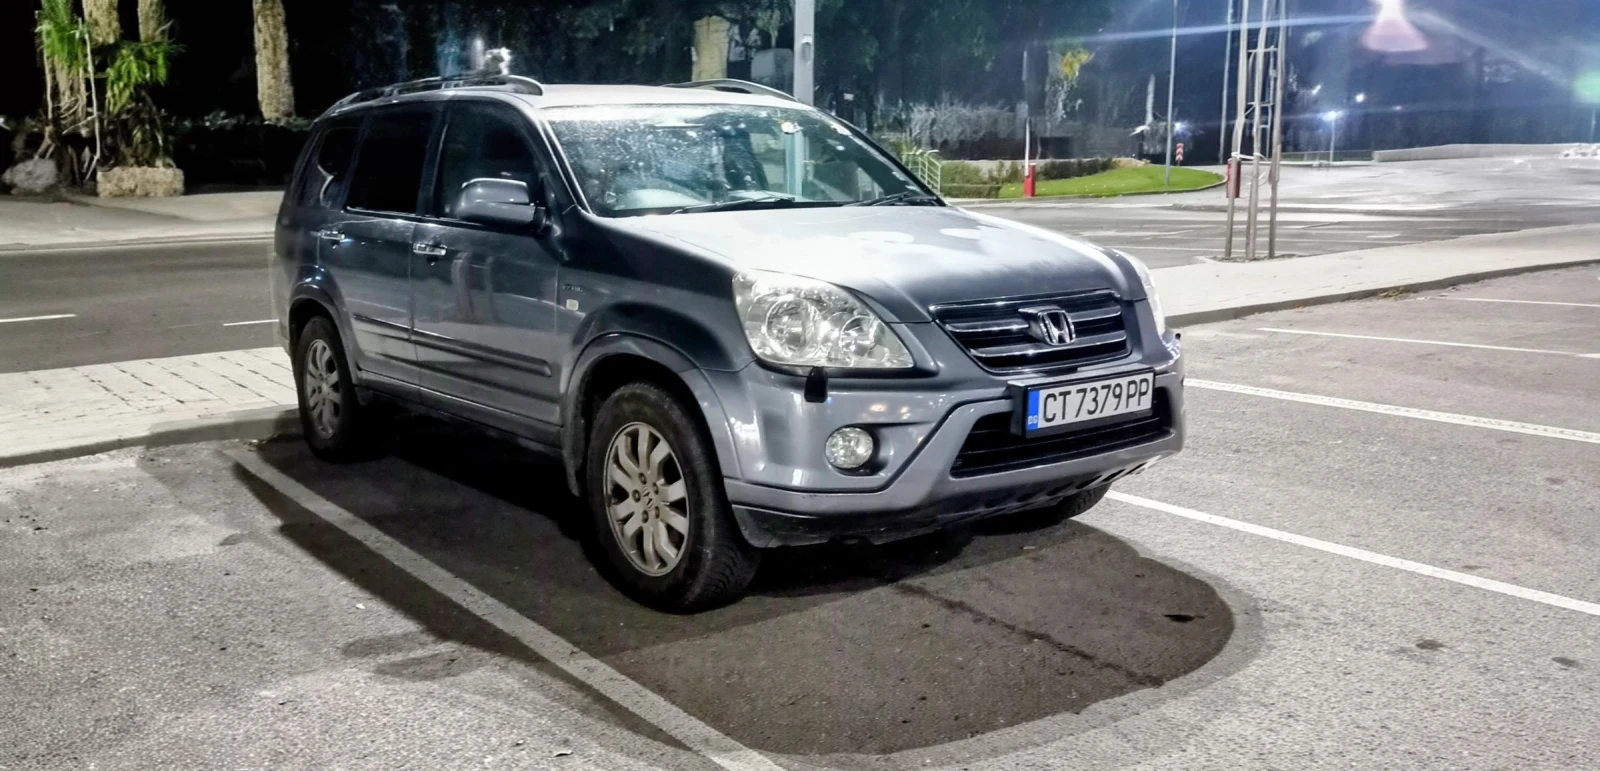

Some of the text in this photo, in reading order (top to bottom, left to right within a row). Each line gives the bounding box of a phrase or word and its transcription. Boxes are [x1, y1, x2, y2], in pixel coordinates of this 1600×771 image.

[1043, 378, 1149, 422] CT 7379 PP
[1027, 415, 1038, 425] BG
